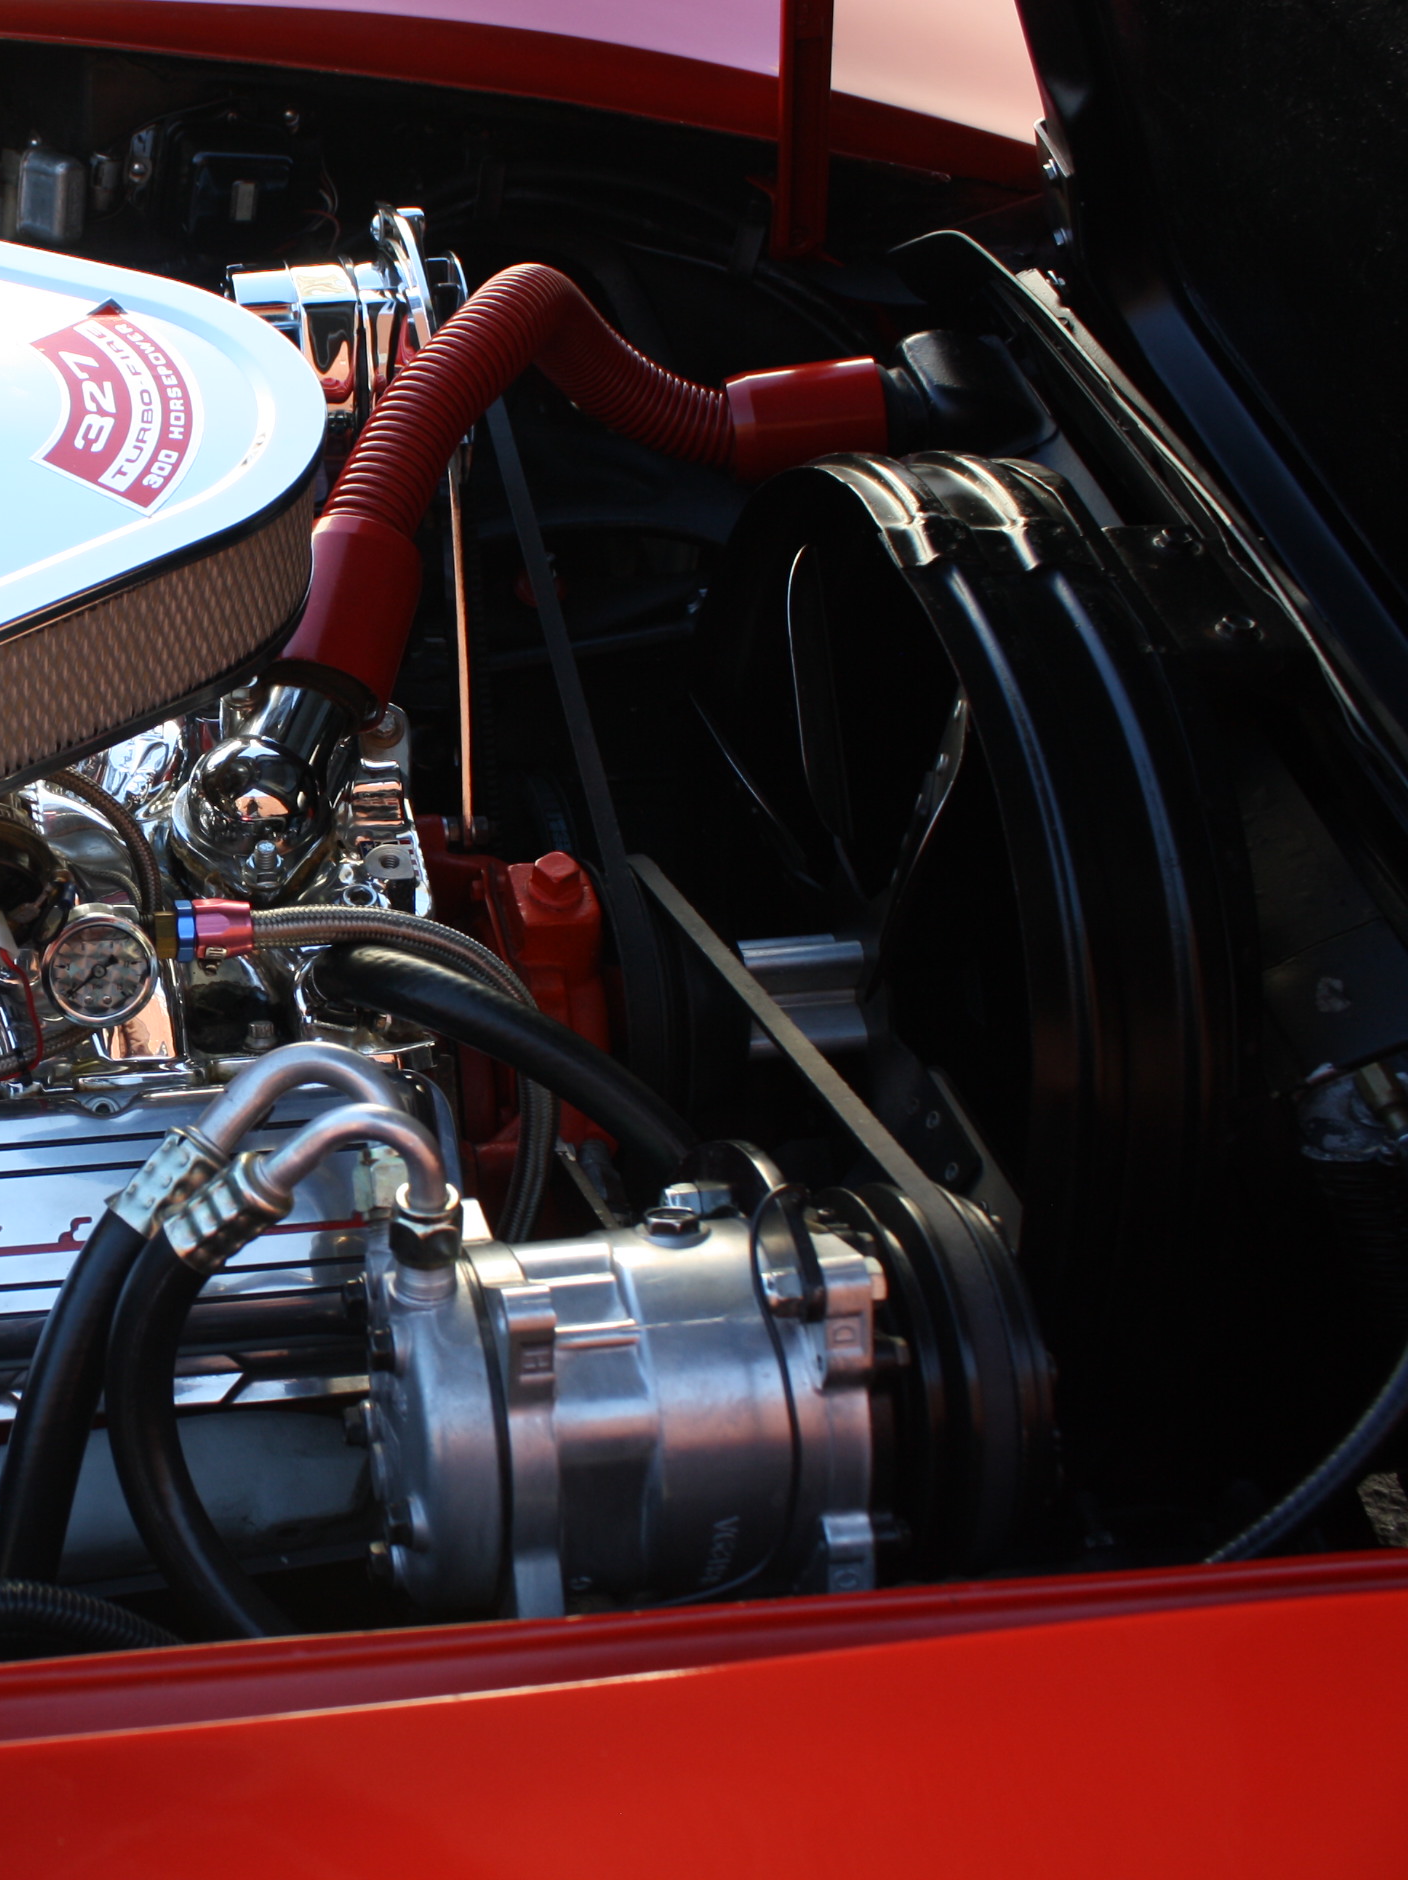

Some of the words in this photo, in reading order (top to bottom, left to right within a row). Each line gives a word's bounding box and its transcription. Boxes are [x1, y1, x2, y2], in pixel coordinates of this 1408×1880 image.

[57, 349, 117, 453] 327
[83, 326, 154, 480] TURBO-FIRE
[114, 322, 186, 440] HORSEPOWER
[141, 449, 180, 489] 300
